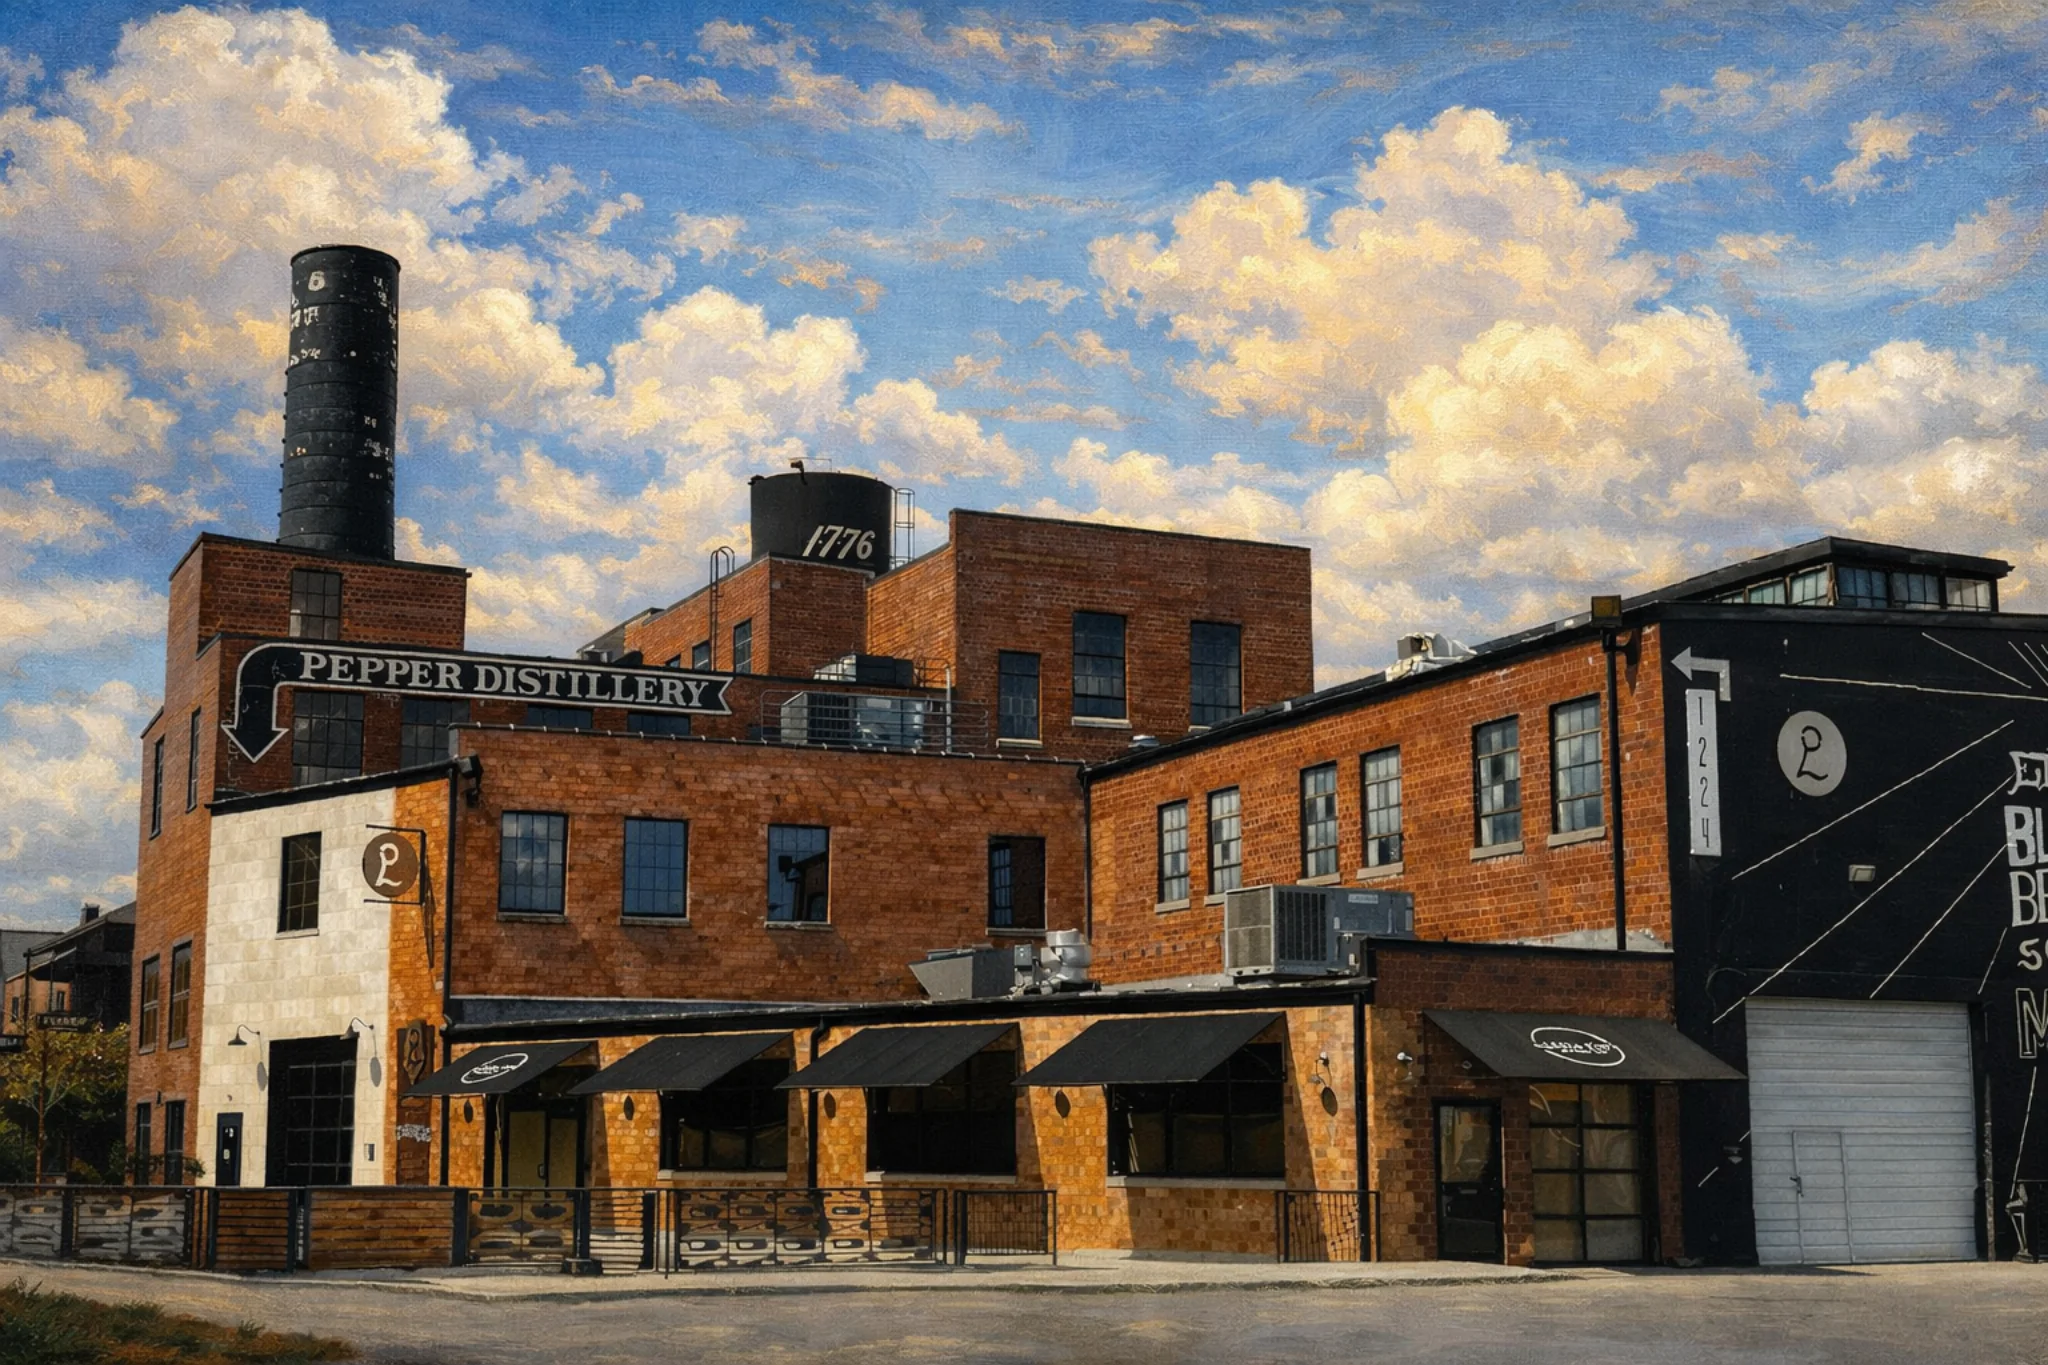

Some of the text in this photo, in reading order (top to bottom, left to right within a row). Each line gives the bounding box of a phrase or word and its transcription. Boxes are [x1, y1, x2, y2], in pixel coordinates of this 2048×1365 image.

[802, 525, 875, 560] 1776
[299, 652, 709, 707] PEPPER DISTILLERY
[2017, 938, 2048, 970] S
